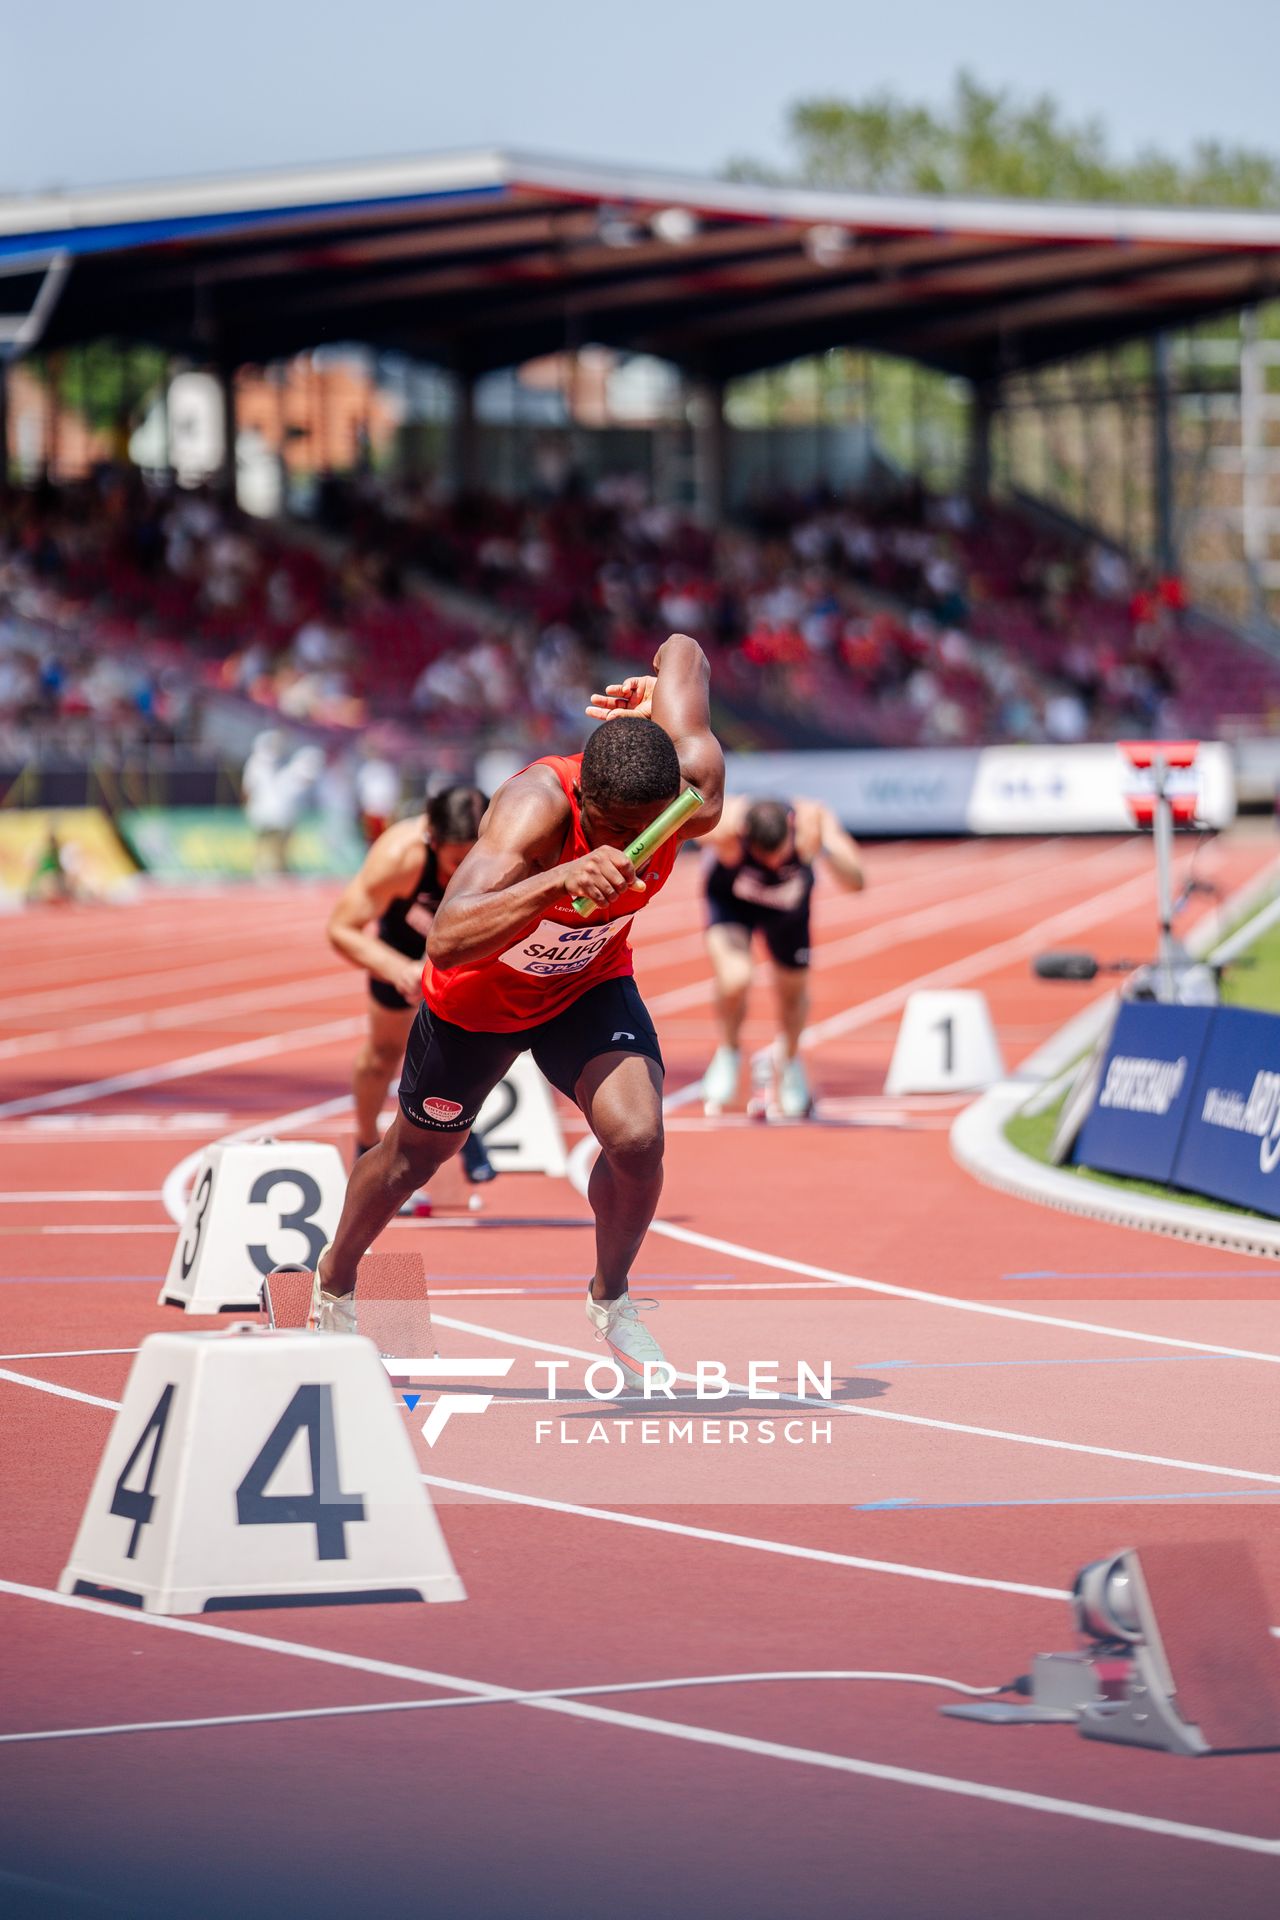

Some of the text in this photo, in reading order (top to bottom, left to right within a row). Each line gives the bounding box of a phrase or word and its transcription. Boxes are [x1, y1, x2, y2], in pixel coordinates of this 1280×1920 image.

[931, 1016, 954, 1076] 1
[481, 1078, 520, 1151] 2
[181, 1167, 213, 1280] 3
[246, 1168, 331, 1275] 3
[109, 1382, 176, 1559] 4
[235, 1382, 367, 1560] 4
